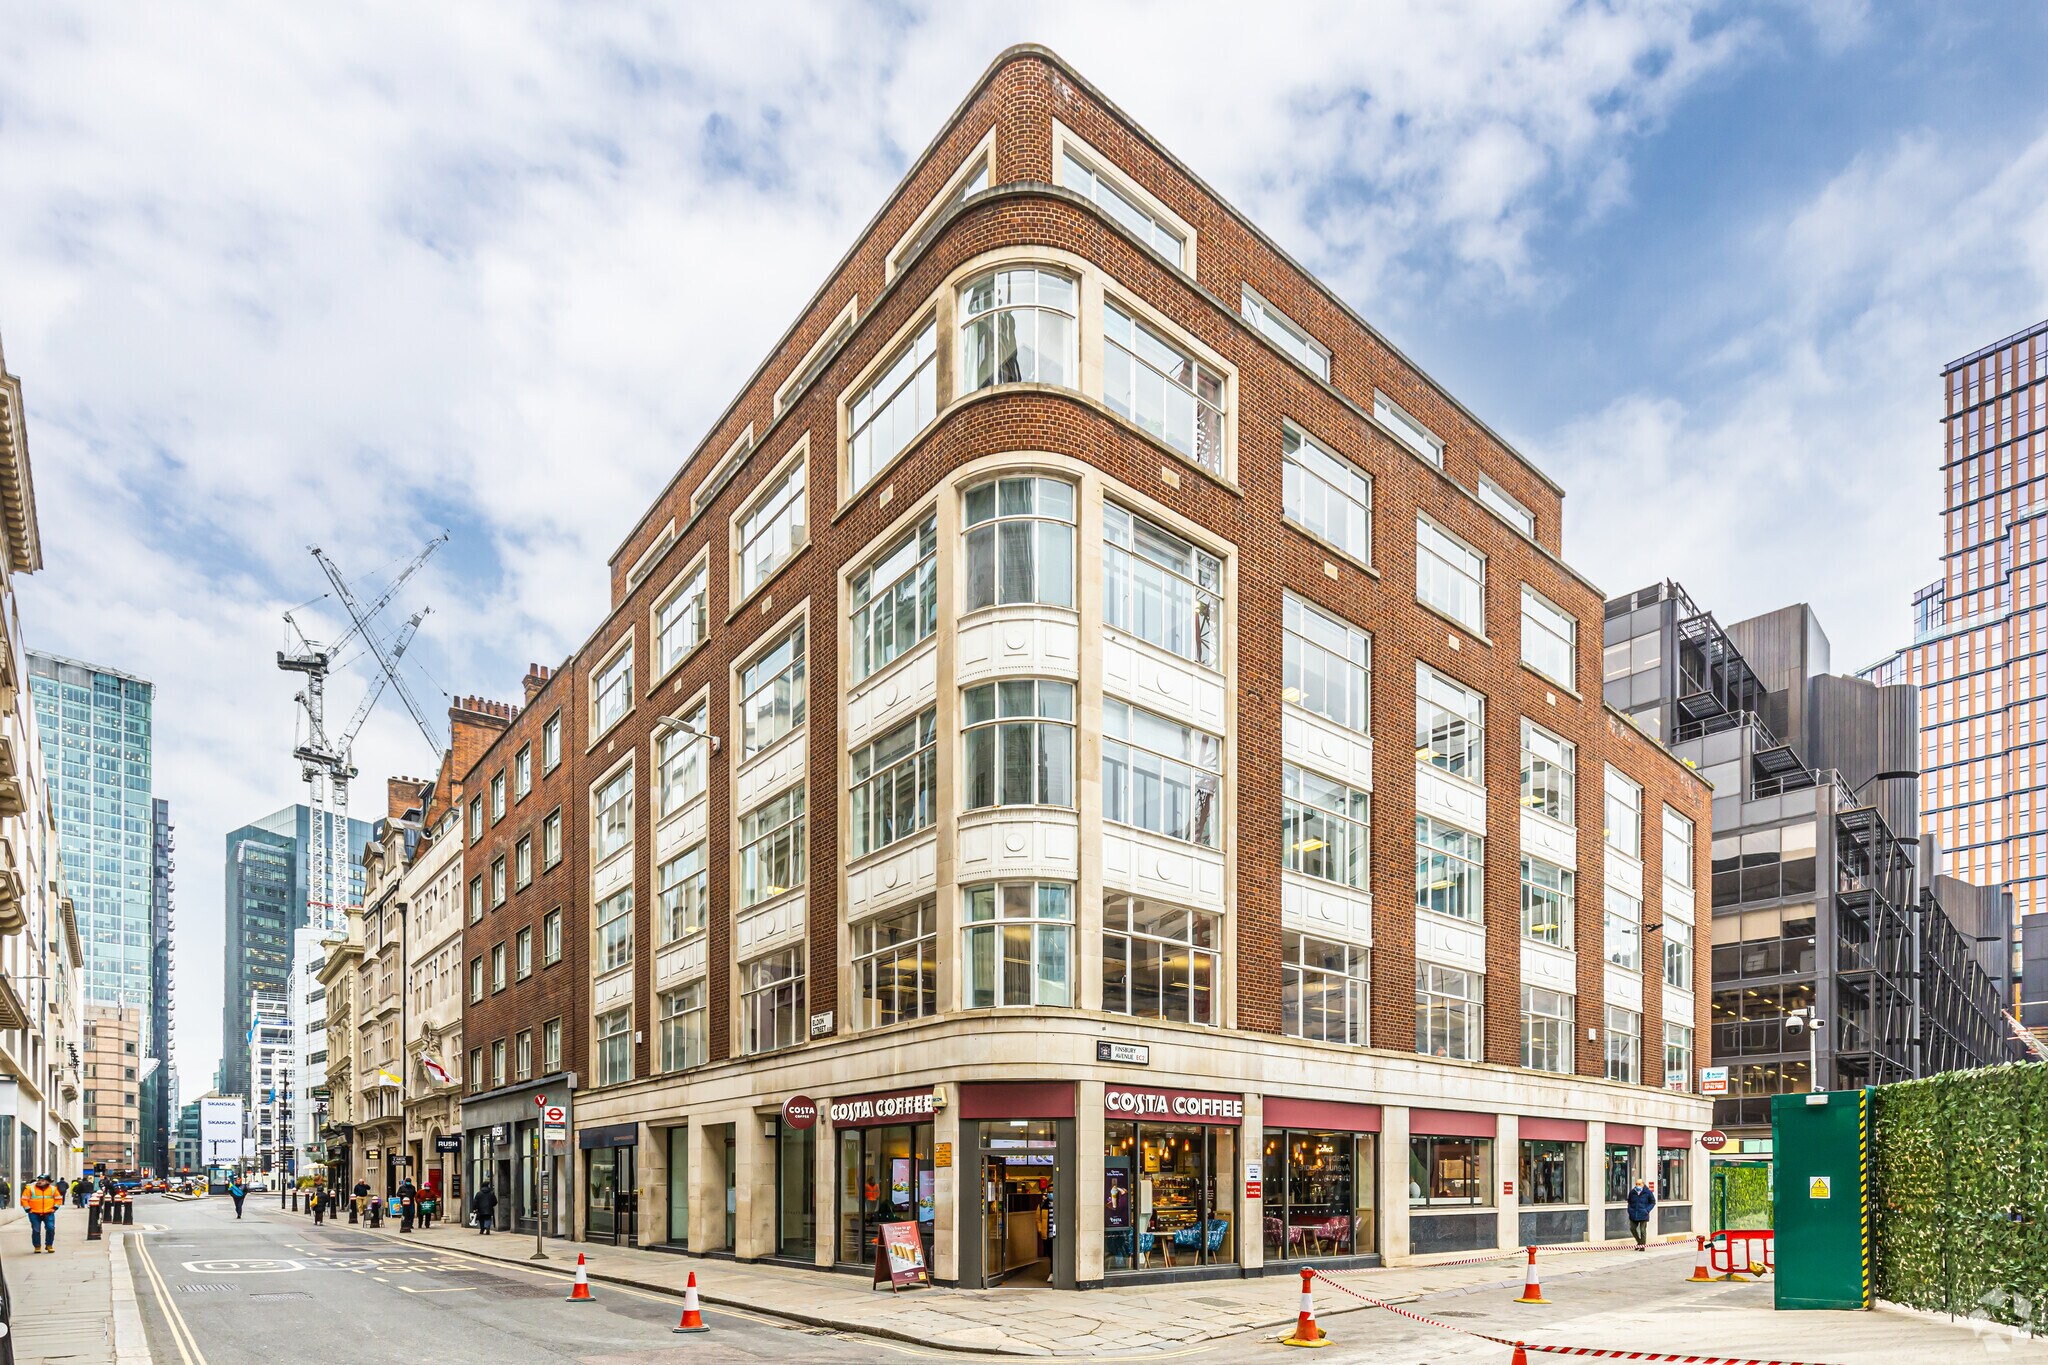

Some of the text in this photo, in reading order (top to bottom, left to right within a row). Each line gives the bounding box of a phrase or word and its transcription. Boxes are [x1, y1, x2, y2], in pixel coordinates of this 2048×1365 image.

[812, 1018, 824, 1026] ELDON
[812, 1025, 826, 1034] STREET
[1114, 1046, 1136, 1054] FINSBURY
[830, 1094, 934, 1121] COSTA COFFEE
[1106, 1092, 1242, 1117] COSTA COFFEE
[377, 1264, 478, 1273] BUS
